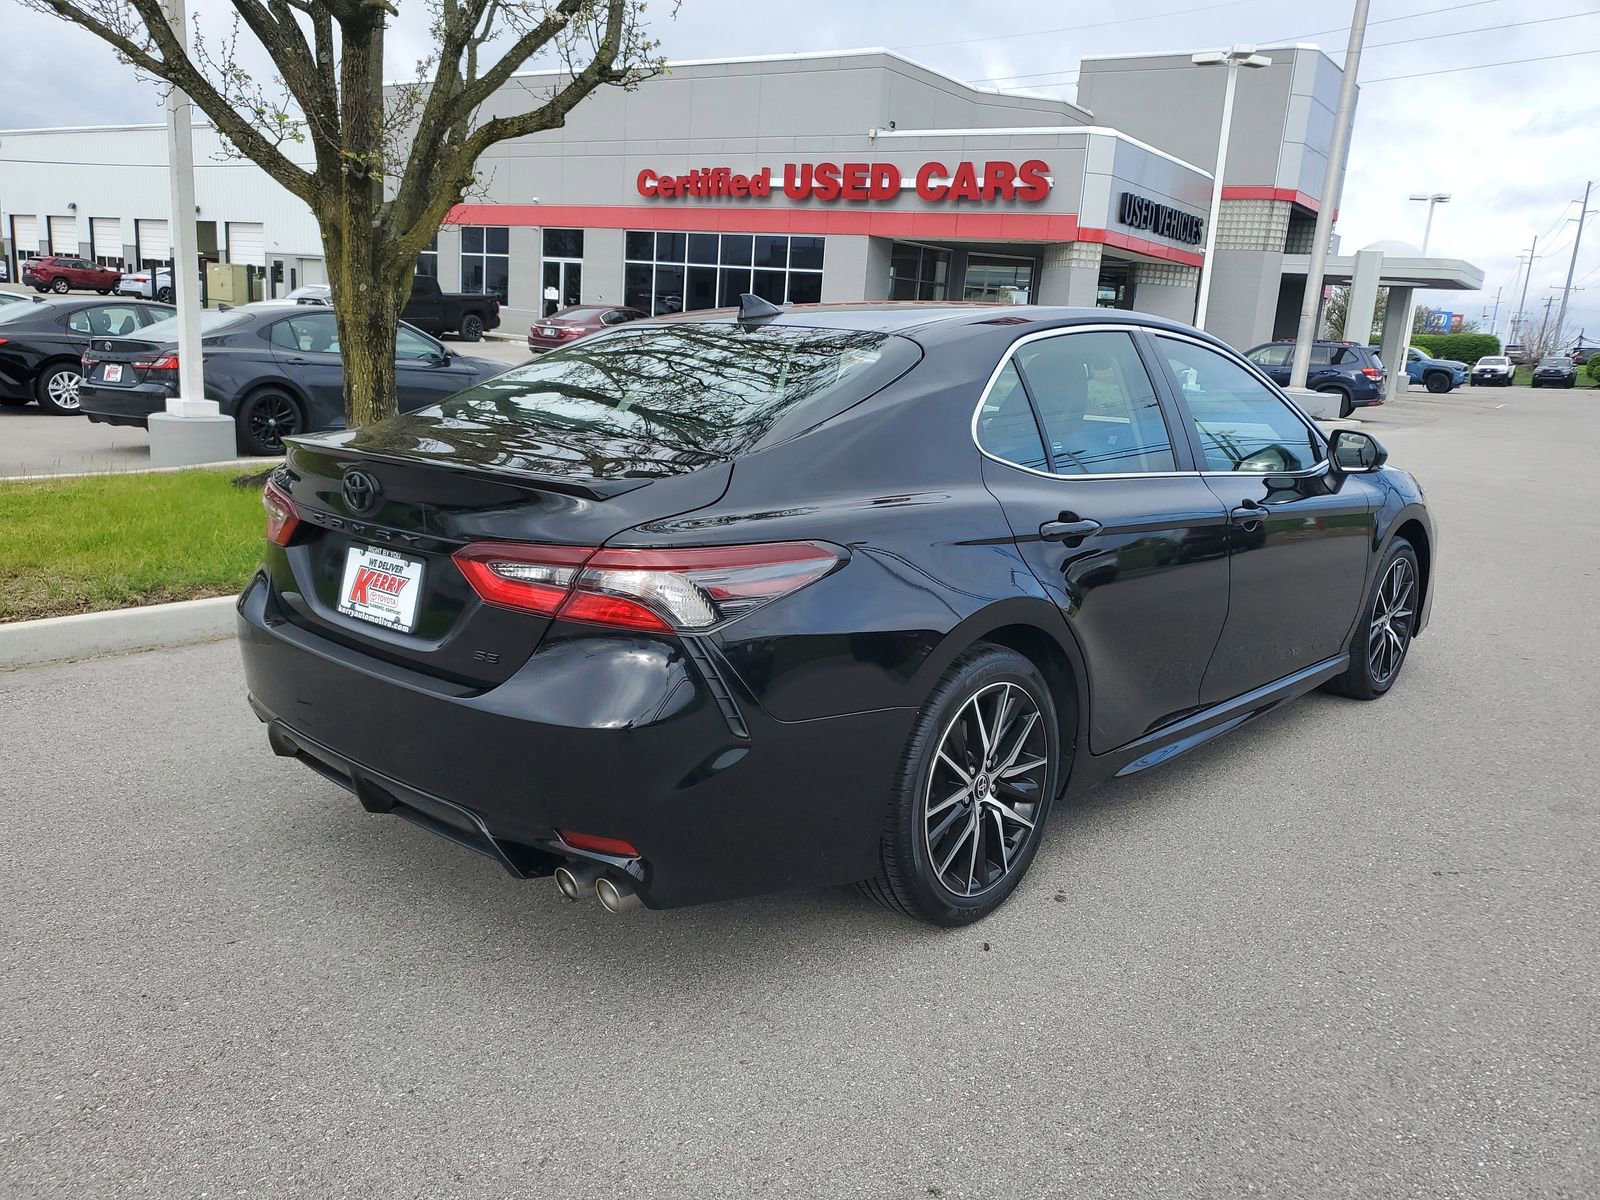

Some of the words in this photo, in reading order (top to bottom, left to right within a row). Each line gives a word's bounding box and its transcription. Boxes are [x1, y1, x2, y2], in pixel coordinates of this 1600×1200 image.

[637, 167, 771, 198] Certified
[783, 162, 902, 202] USED
[915, 159, 1053, 202] CARS
[1120, 192, 1156, 231] USED
[1157, 204, 1204, 244] VEHICLES
[368, 546, 382, 555] RIGHT
[382, 548, 390, 557] BY
[390, 550, 401, 560] YOU
[368, 558, 378, 568] WE
[378, 560, 404, 575] DELIVER
[348, 565, 410, 608] KERRY
[376, 595, 396, 605] TOYOTA
[339, 606, 409, 632] kerryautomotive.com
[473, 651, 500, 664] SE
